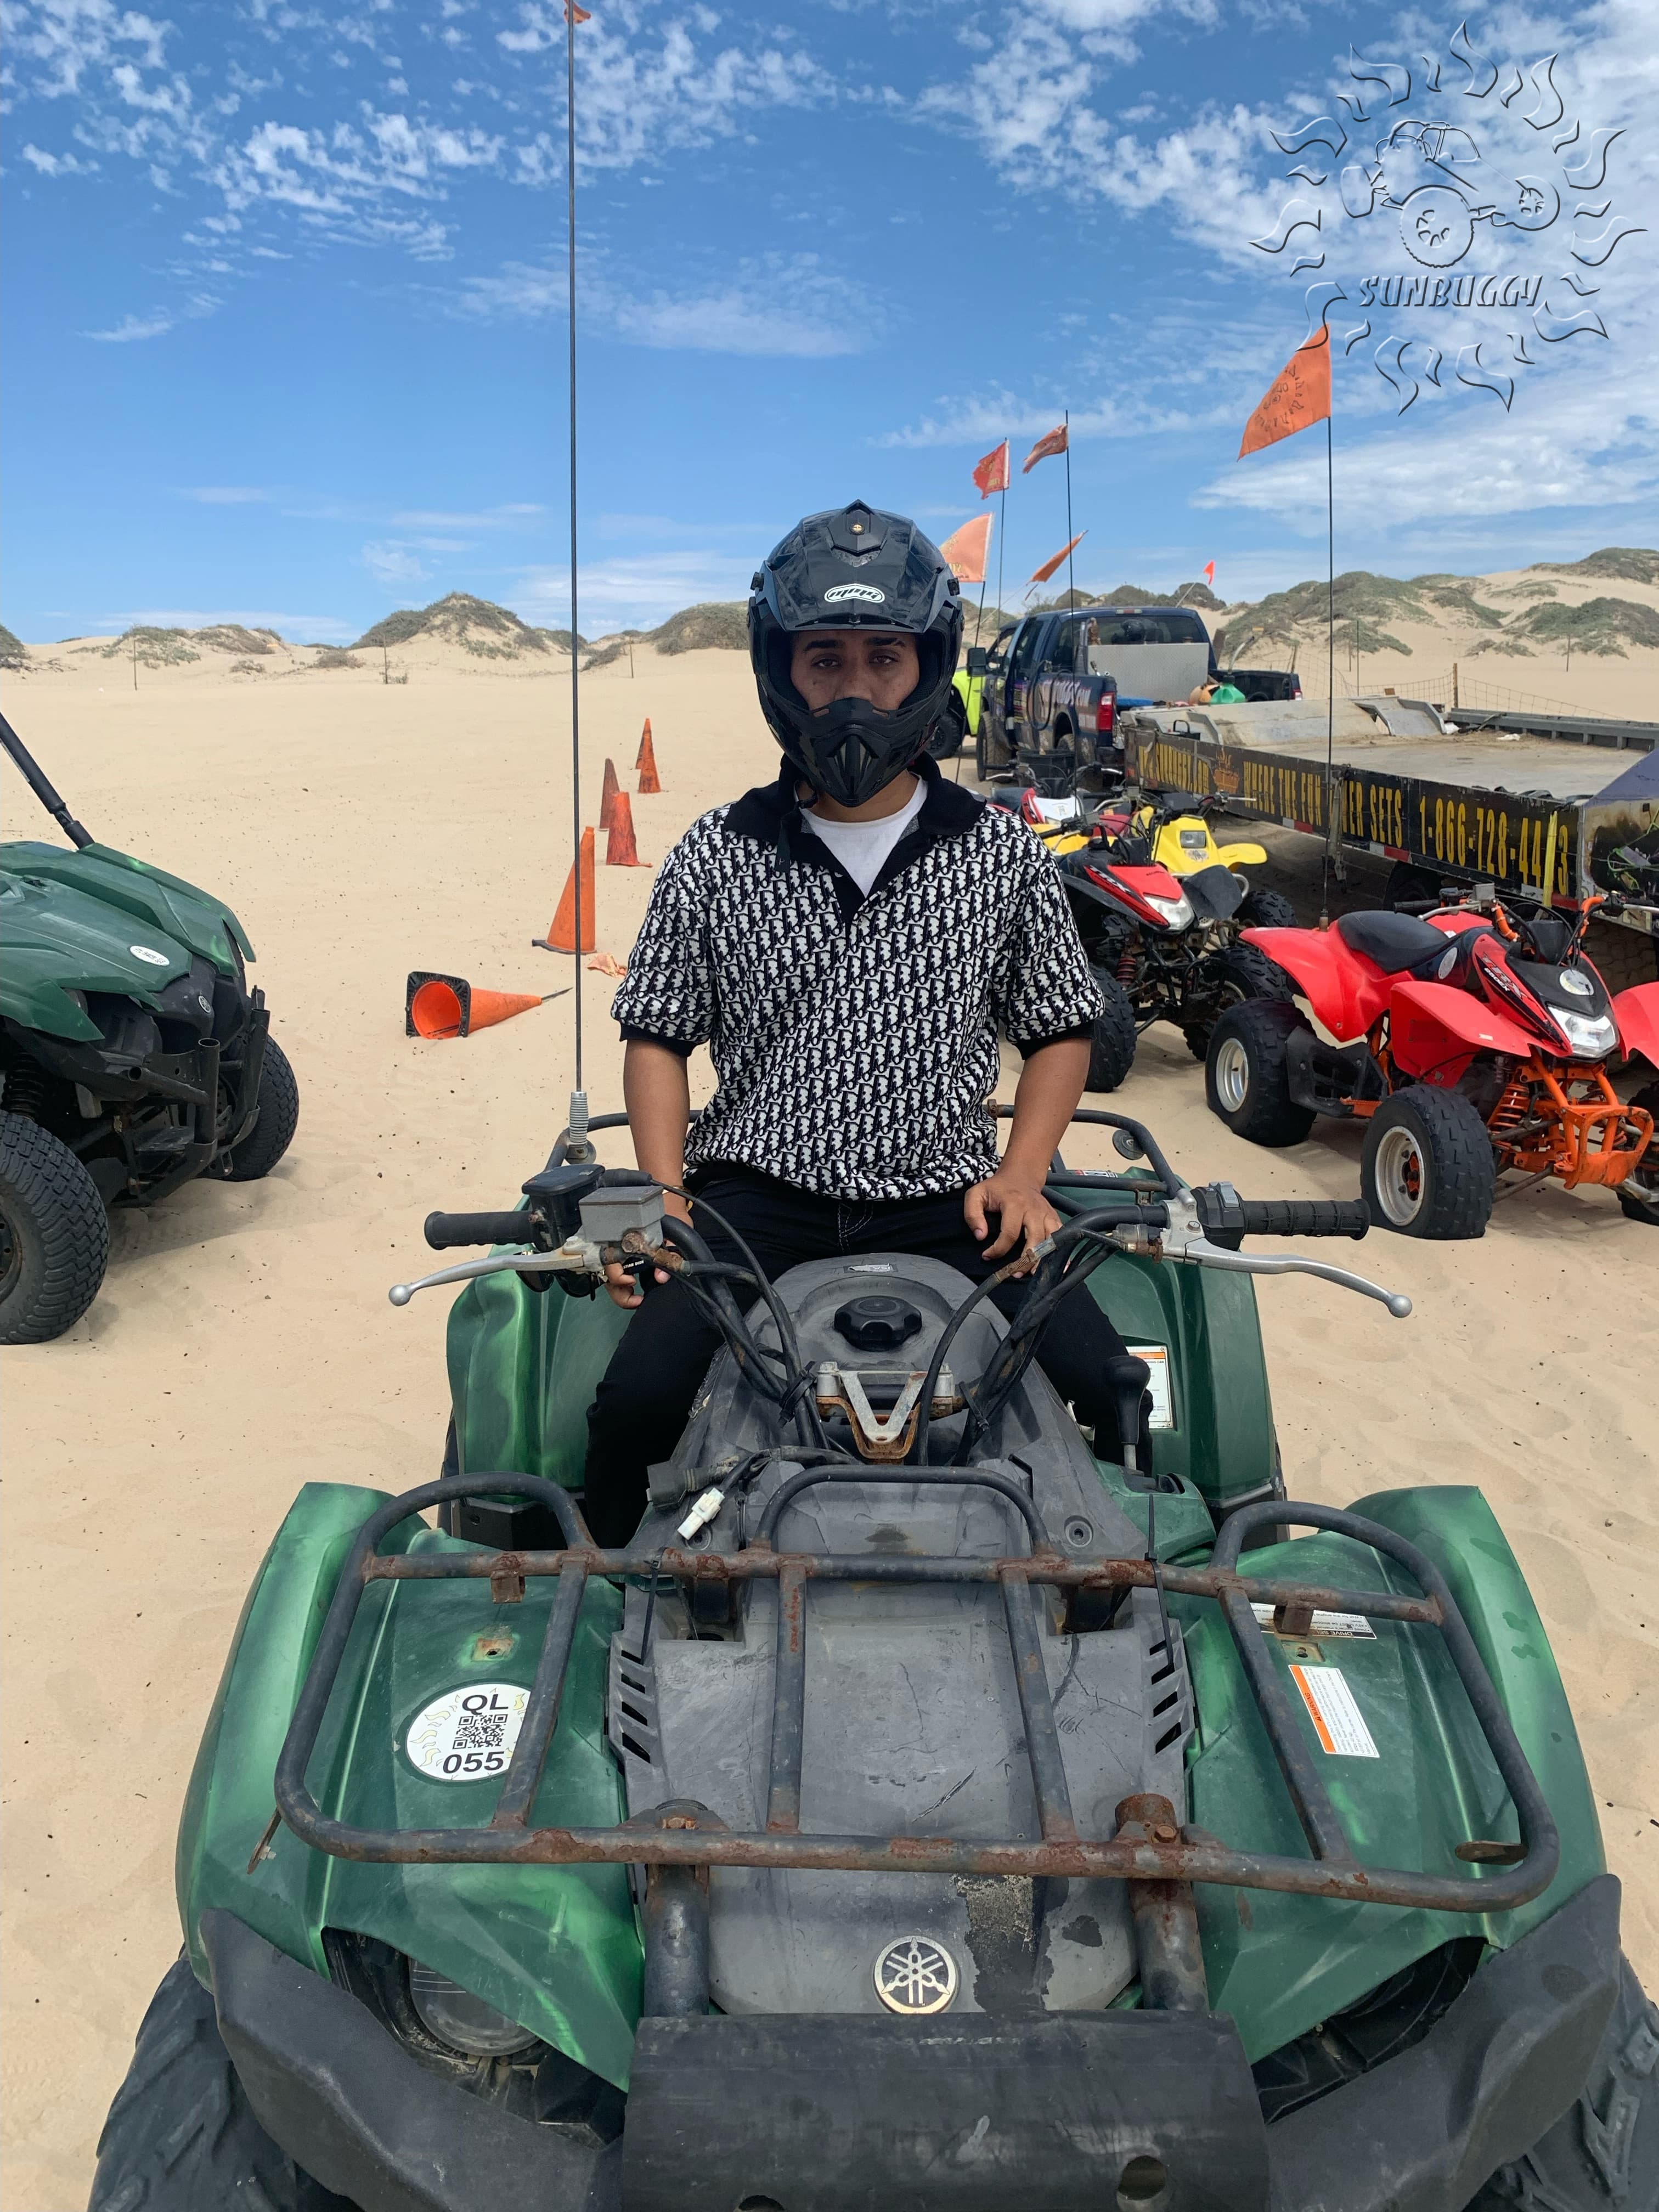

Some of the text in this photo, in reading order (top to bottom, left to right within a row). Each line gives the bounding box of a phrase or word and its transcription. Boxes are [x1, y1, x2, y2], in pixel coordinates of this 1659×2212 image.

[1243, 761, 1275, 815] WHERE
[1278, 768, 1297, 820] THE
[1301, 772, 1322, 826] FUN
[1370, 784, 1402, 848] SETS
[1419, 795, 1568, 896] 1-866-728-443
[462, 1694, 509, 1716] QL
[443, 1751, 505, 1774] 055
